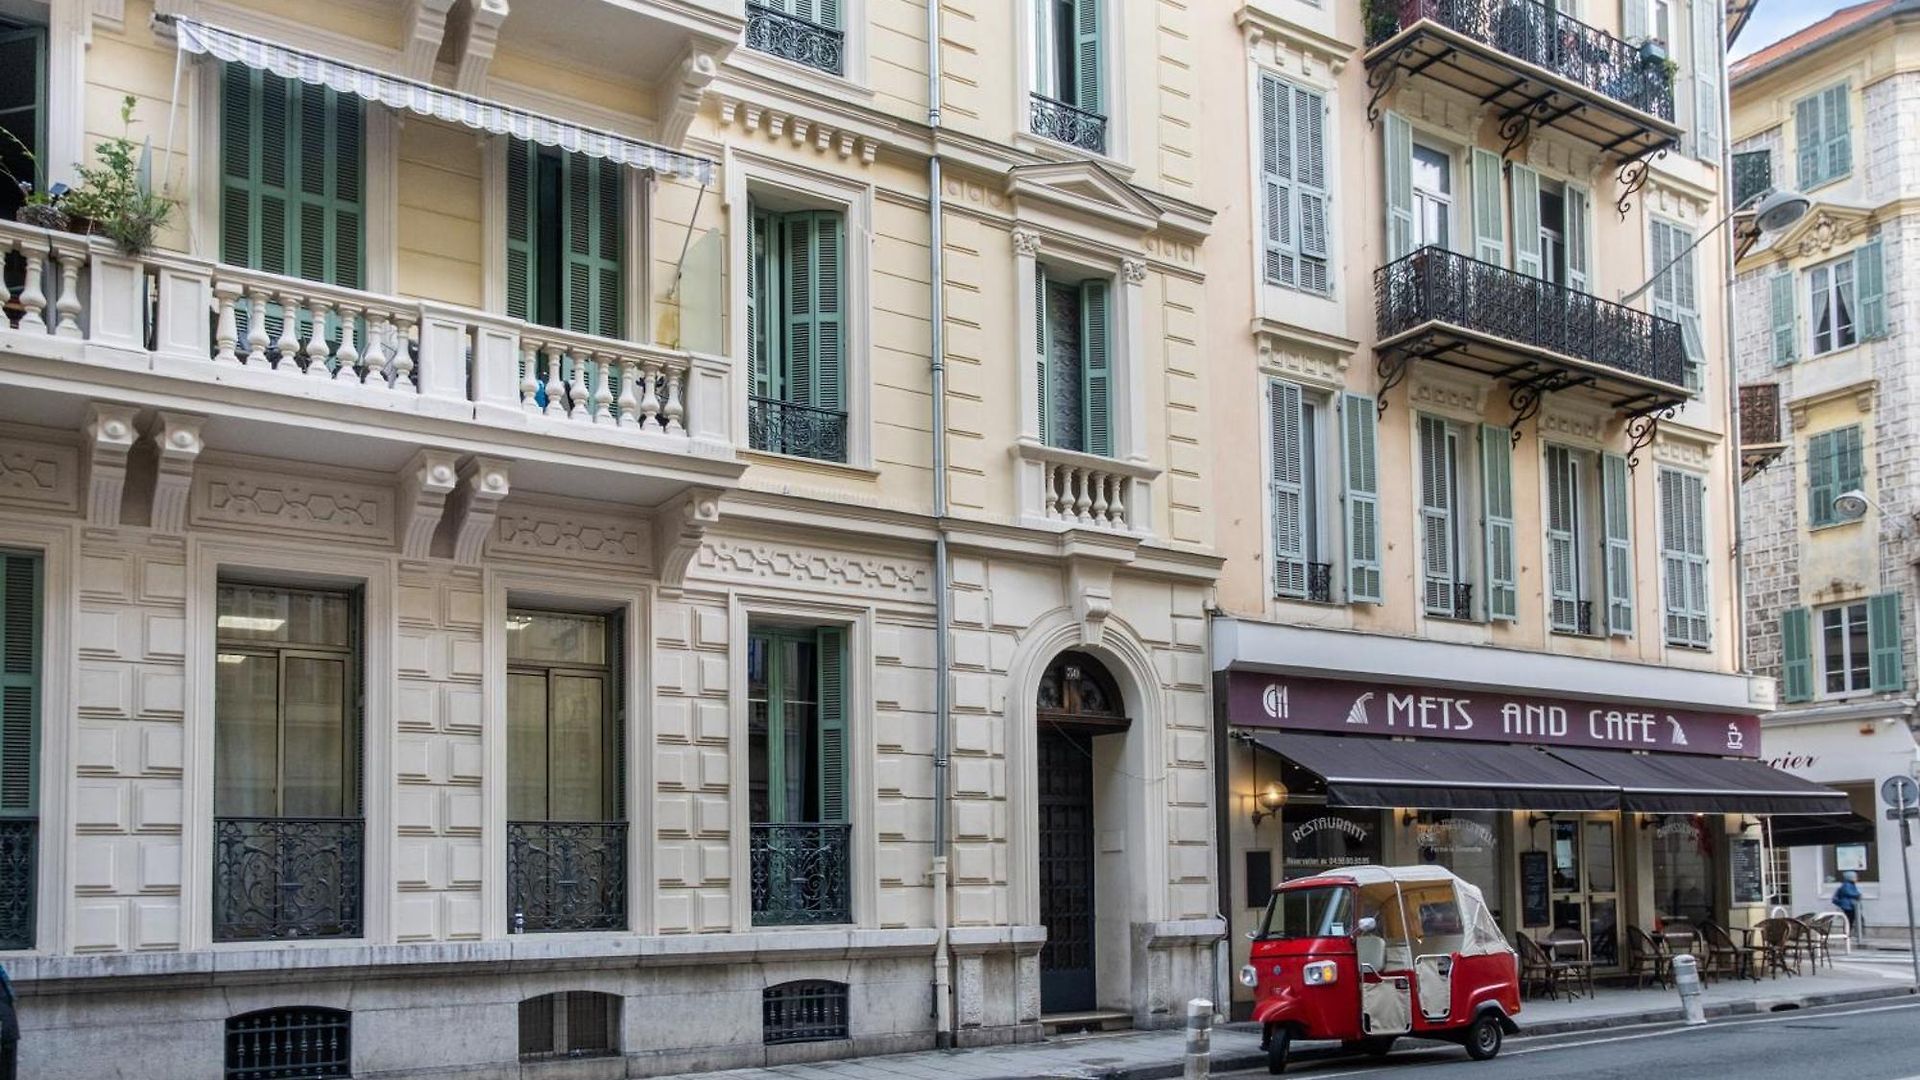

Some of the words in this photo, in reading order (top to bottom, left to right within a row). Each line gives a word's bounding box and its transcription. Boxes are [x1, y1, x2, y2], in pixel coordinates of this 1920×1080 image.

[1386, 692, 1474, 730] METS
[1501, 703, 1567, 737] AND
[1589, 709, 1656, 743] CAFE
[1292, 816, 1367, 843] RESTAURANT
